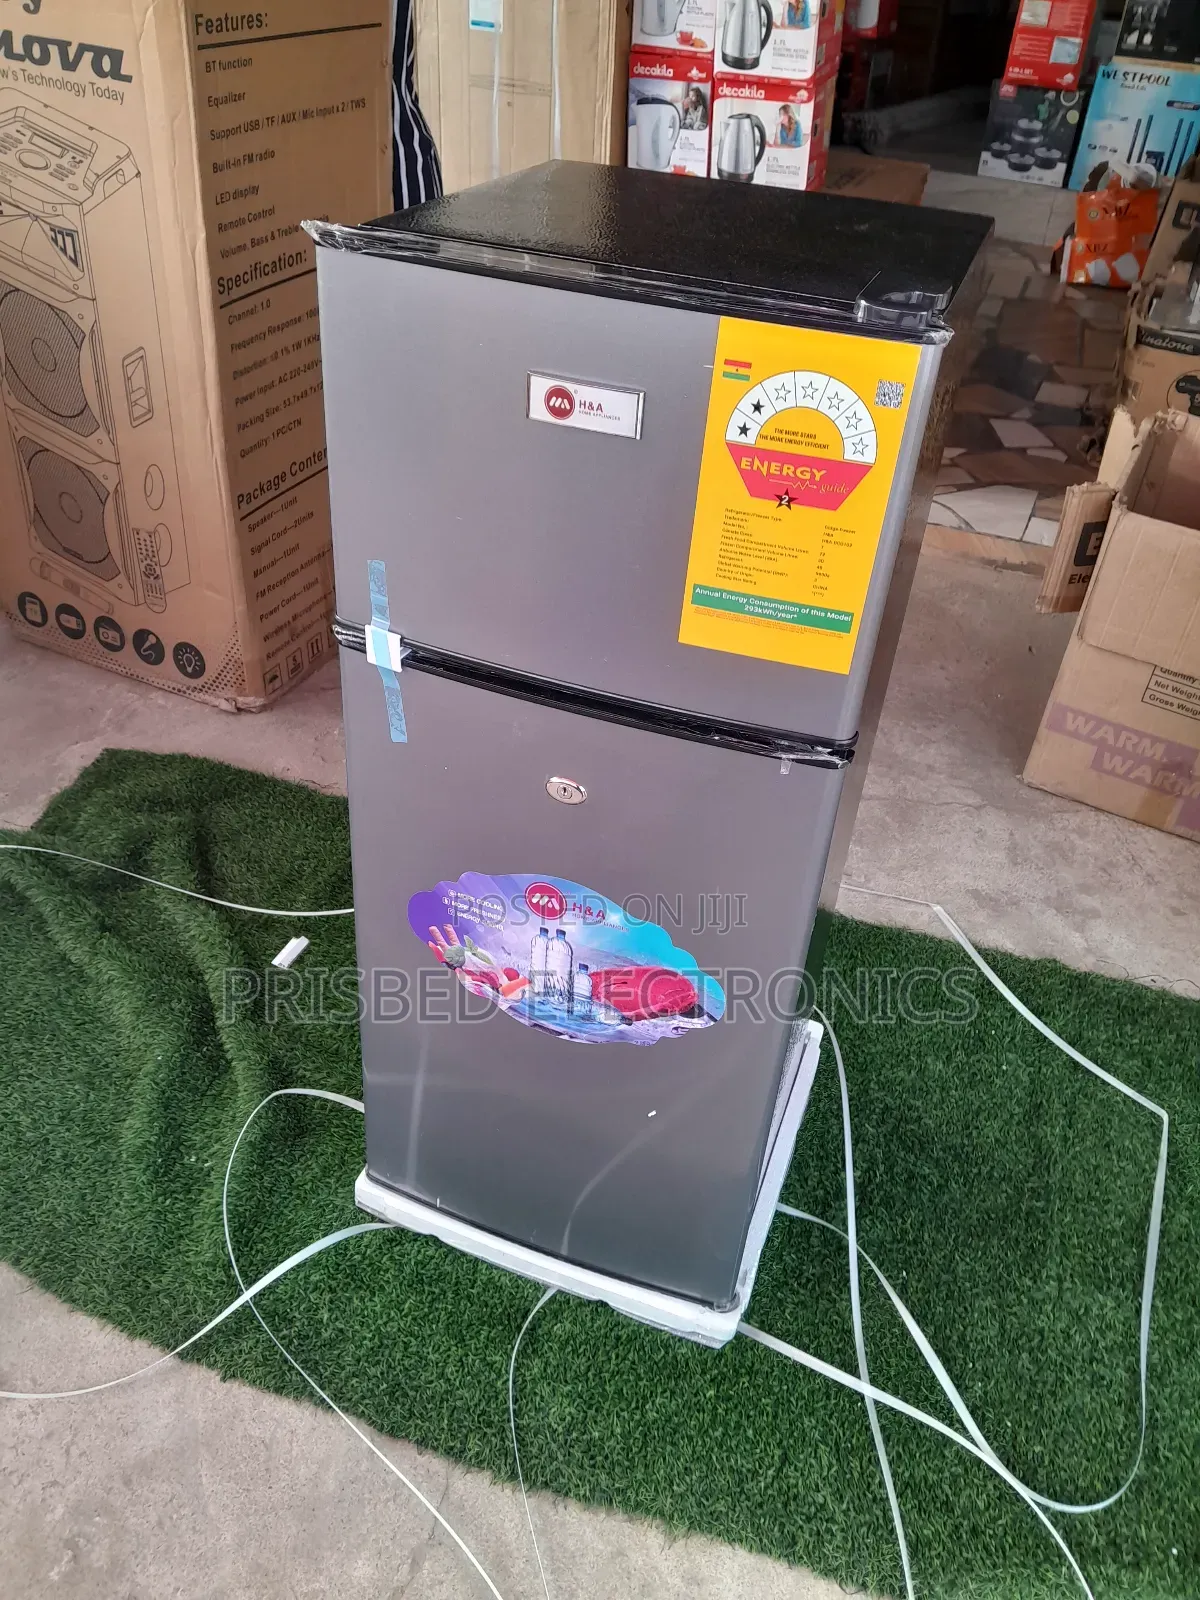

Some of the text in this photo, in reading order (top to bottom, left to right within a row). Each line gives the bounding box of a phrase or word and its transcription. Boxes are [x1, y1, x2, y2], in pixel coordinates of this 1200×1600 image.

[195, 12, 268, 35] Features:
[205, 56, 253, 73] BT function
[633, 62, 674, 77] decakila
[20, 68, 87, 98] Technology
[88, 81, 125, 105] Today
[718, 83, 765, 99] decakila
[207, 91, 246, 109] Equalizer
[210, 123, 242, 141] Support
[243, 120, 261, 133] USB
[265, 116, 275, 128] TF
[280, 111, 297, 124] AUX
[302, 107, 315, 120] Mic
[316, 104, 335, 120] Input
[350, 97, 367, 111] TWS
[243, 152, 255, 166] FM
[256, 149, 276, 162] radio
[215, 184, 260, 206] LED display
[218, 205, 276, 234] Remote Control
[250, 235, 269, 249] Bass
[270, 230, 276, 241] &
[217, 249, 308, 295] Specification:
[230, 329, 267, 355] Frequency
[234, 390, 256, 408] Power
[278, 372, 288, 384] AC
[579, 398, 604, 413] H&A
[237, 413, 265, 433] Packing
[760, 434, 830, 450] THE MORE ENERGY EFFICIENT
[784, 429, 800, 438] MORE
[800, 432, 817, 440] STARS
[740, 454, 827, 482] ENERGY
[236, 471, 287, 510] Package
[819, 482, 850, 494] guide
[781, 494, 789, 505] 2
[250, 536, 271, 556] Signal
[255, 588, 266, 601] FM
[267, 568, 300, 594] Reception
[260, 604, 281, 624] Power
[695, 586, 852, 622] Annual Energy Consumption of this Model
[1154, 679, 1169, 692] Net
[1148, 693, 1175, 708] Gross
[1065, 711, 1167, 762] WARM
[571, 901, 606, 921] H&A
